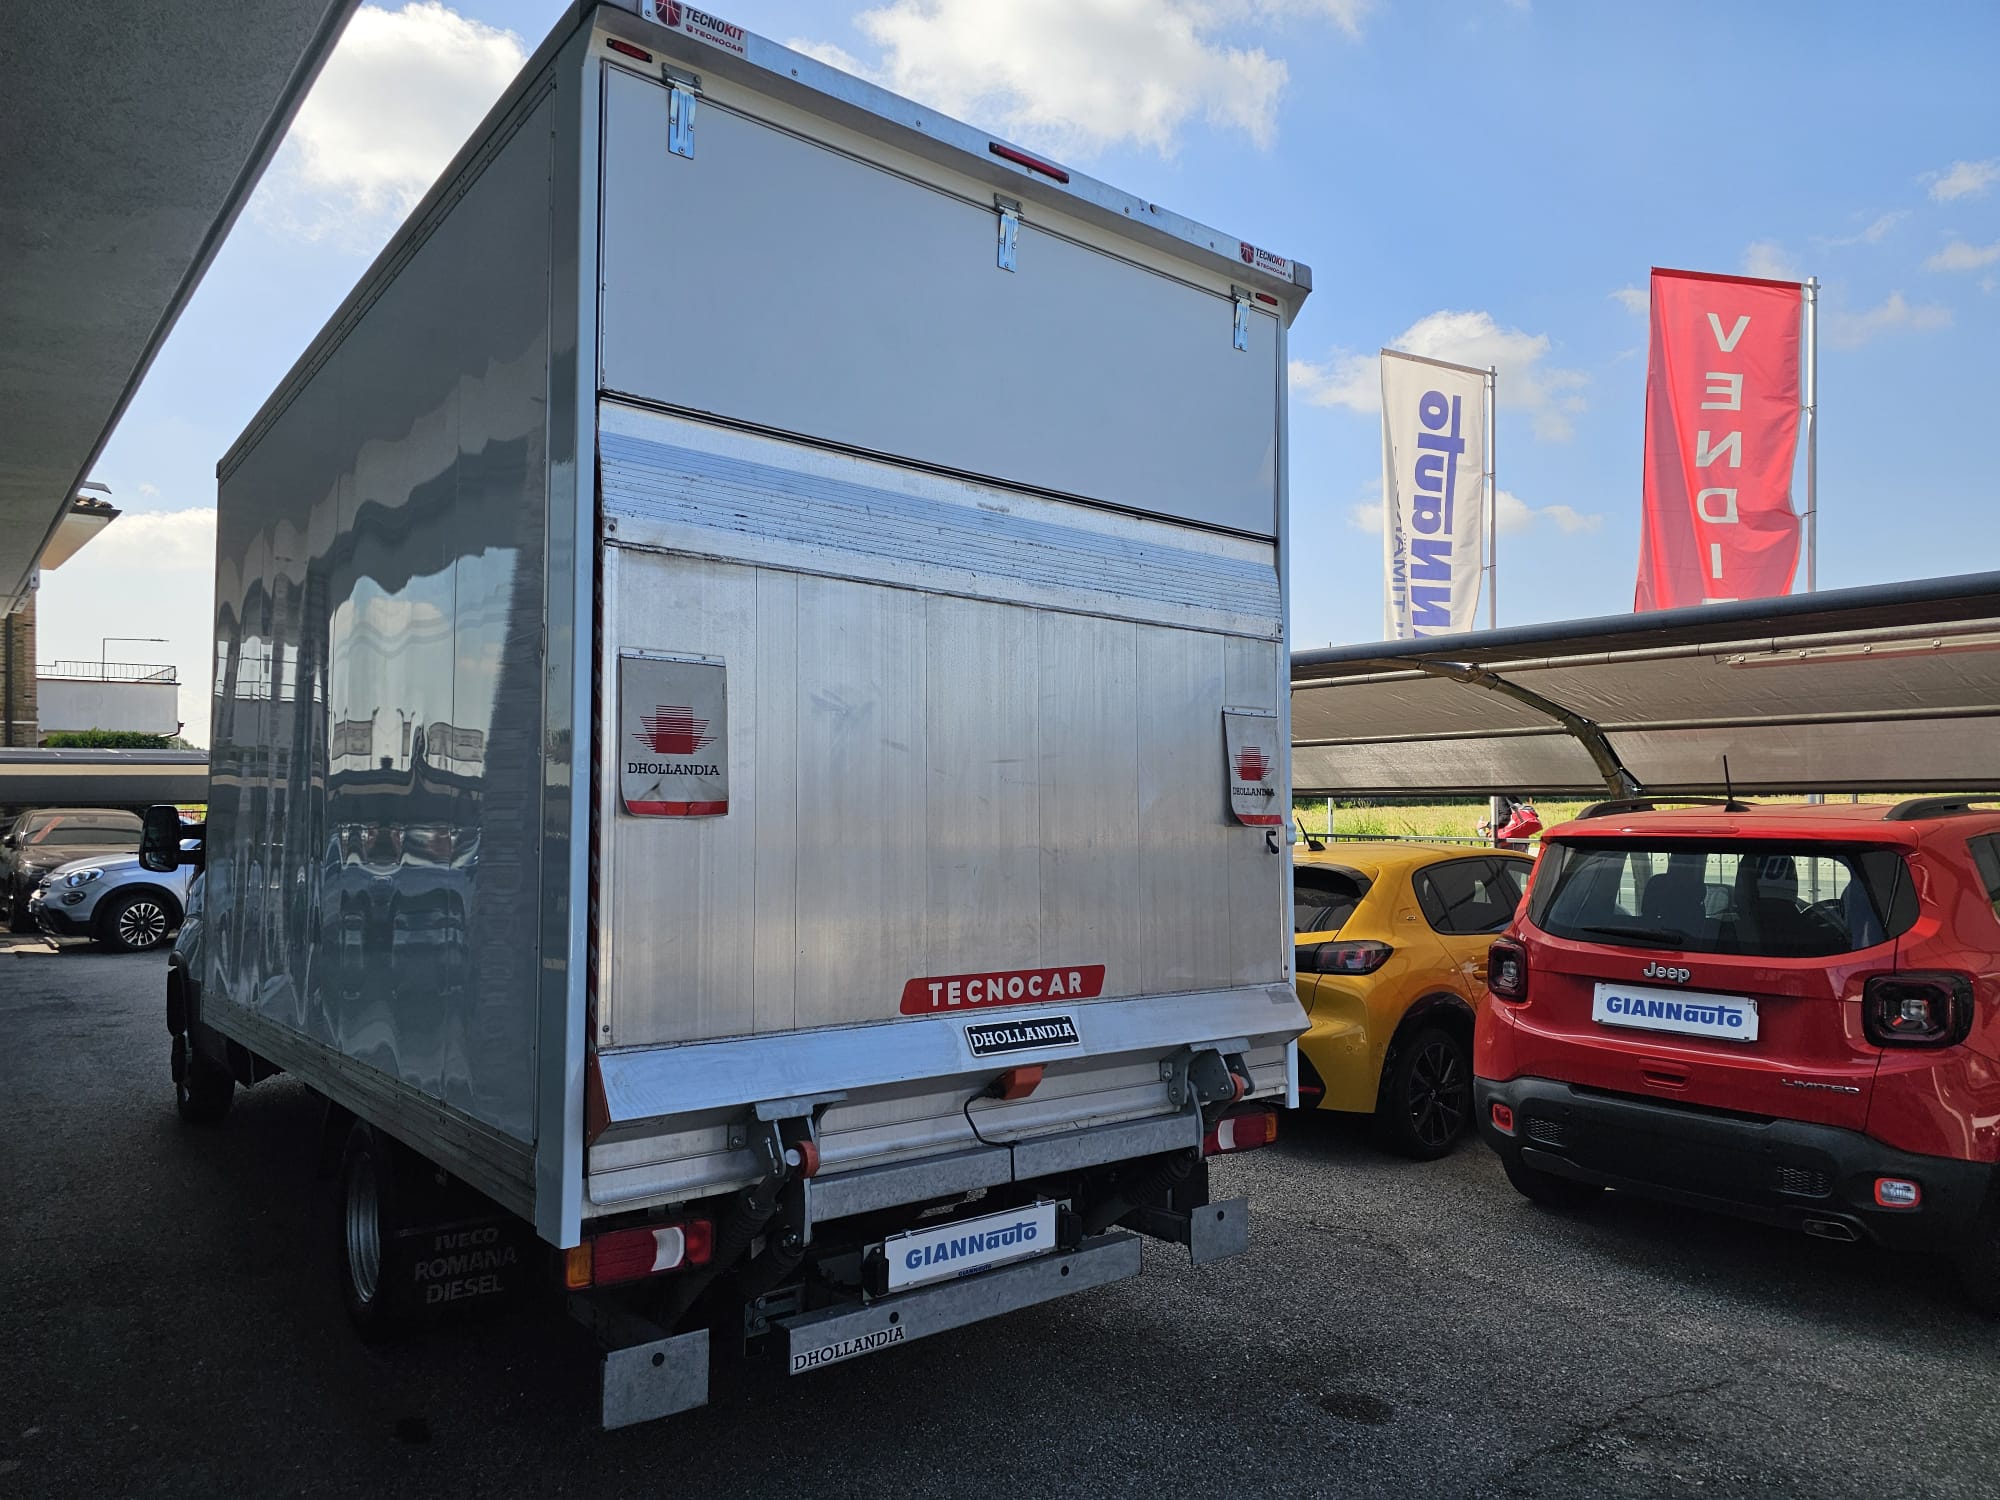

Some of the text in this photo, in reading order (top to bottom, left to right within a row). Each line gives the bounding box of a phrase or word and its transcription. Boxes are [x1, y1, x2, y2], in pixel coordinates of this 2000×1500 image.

[684, 6, 745, 41] TECNOKIT
[694, 27, 744, 54] TECNOCAR
[1255, 247, 1287, 268] TECNOKIT
[627, 762, 720, 776] DHOLLANDIA
[1643, 962, 1690, 983] Jeep
[928, 971, 1082, 1007] TECNOCAR
[1606, 996, 1743, 1028] GIANNauto
[970, 1022, 1076, 1048] DHOLLANDIA
[434, 1227, 498, 1251] IVECO
[905, 1220, 1038, 1270] GIANNauto
[414, 1246, 518, 1281] ROMANA
[425, 1274, 505, 1304] DIESEL
[794, 1326, 905, 1371] DHOLLANDIA
